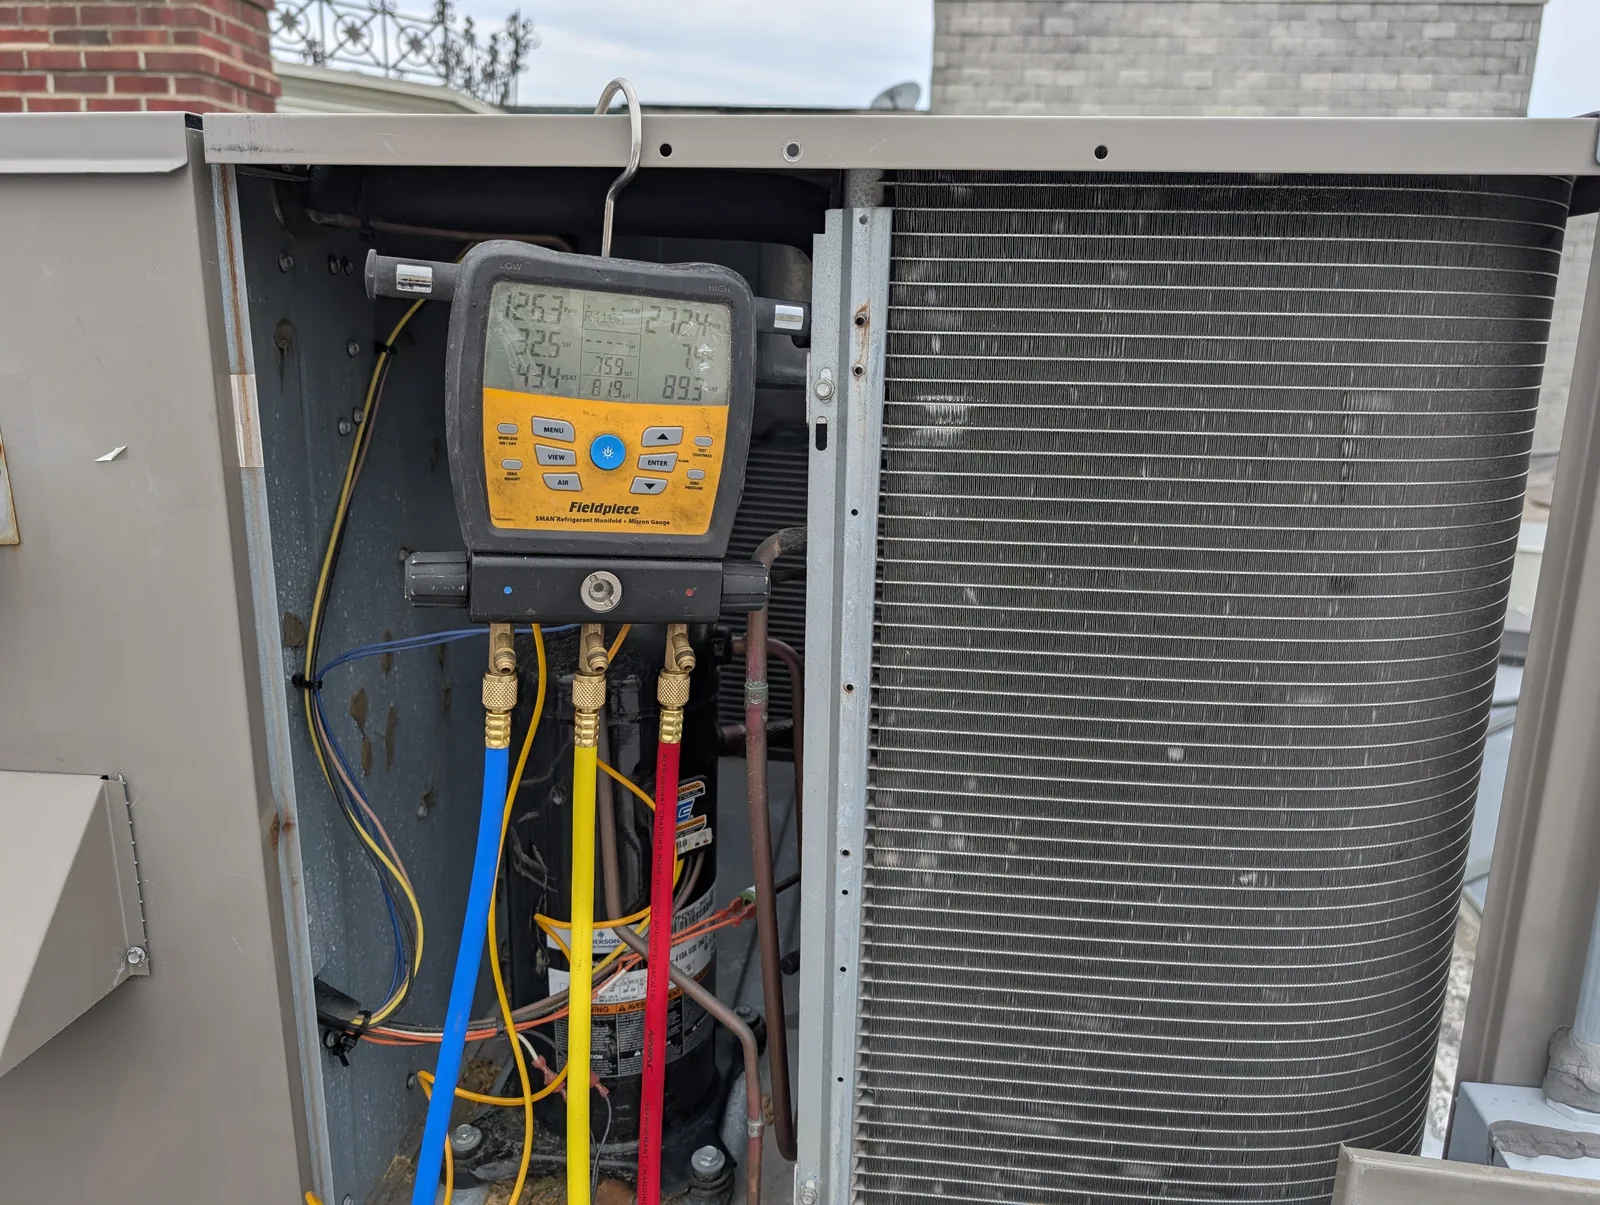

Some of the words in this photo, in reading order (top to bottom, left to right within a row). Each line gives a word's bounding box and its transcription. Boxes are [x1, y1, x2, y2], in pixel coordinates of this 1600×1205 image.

[500, 261, 522, 270] LOW
[708, 284, 730, 293] HIGH
[561, 373, 577, 381] VSAT
[569, 501, 640, 516] Fieldpiece
[557, 516, 593, 524] Refrigerant
